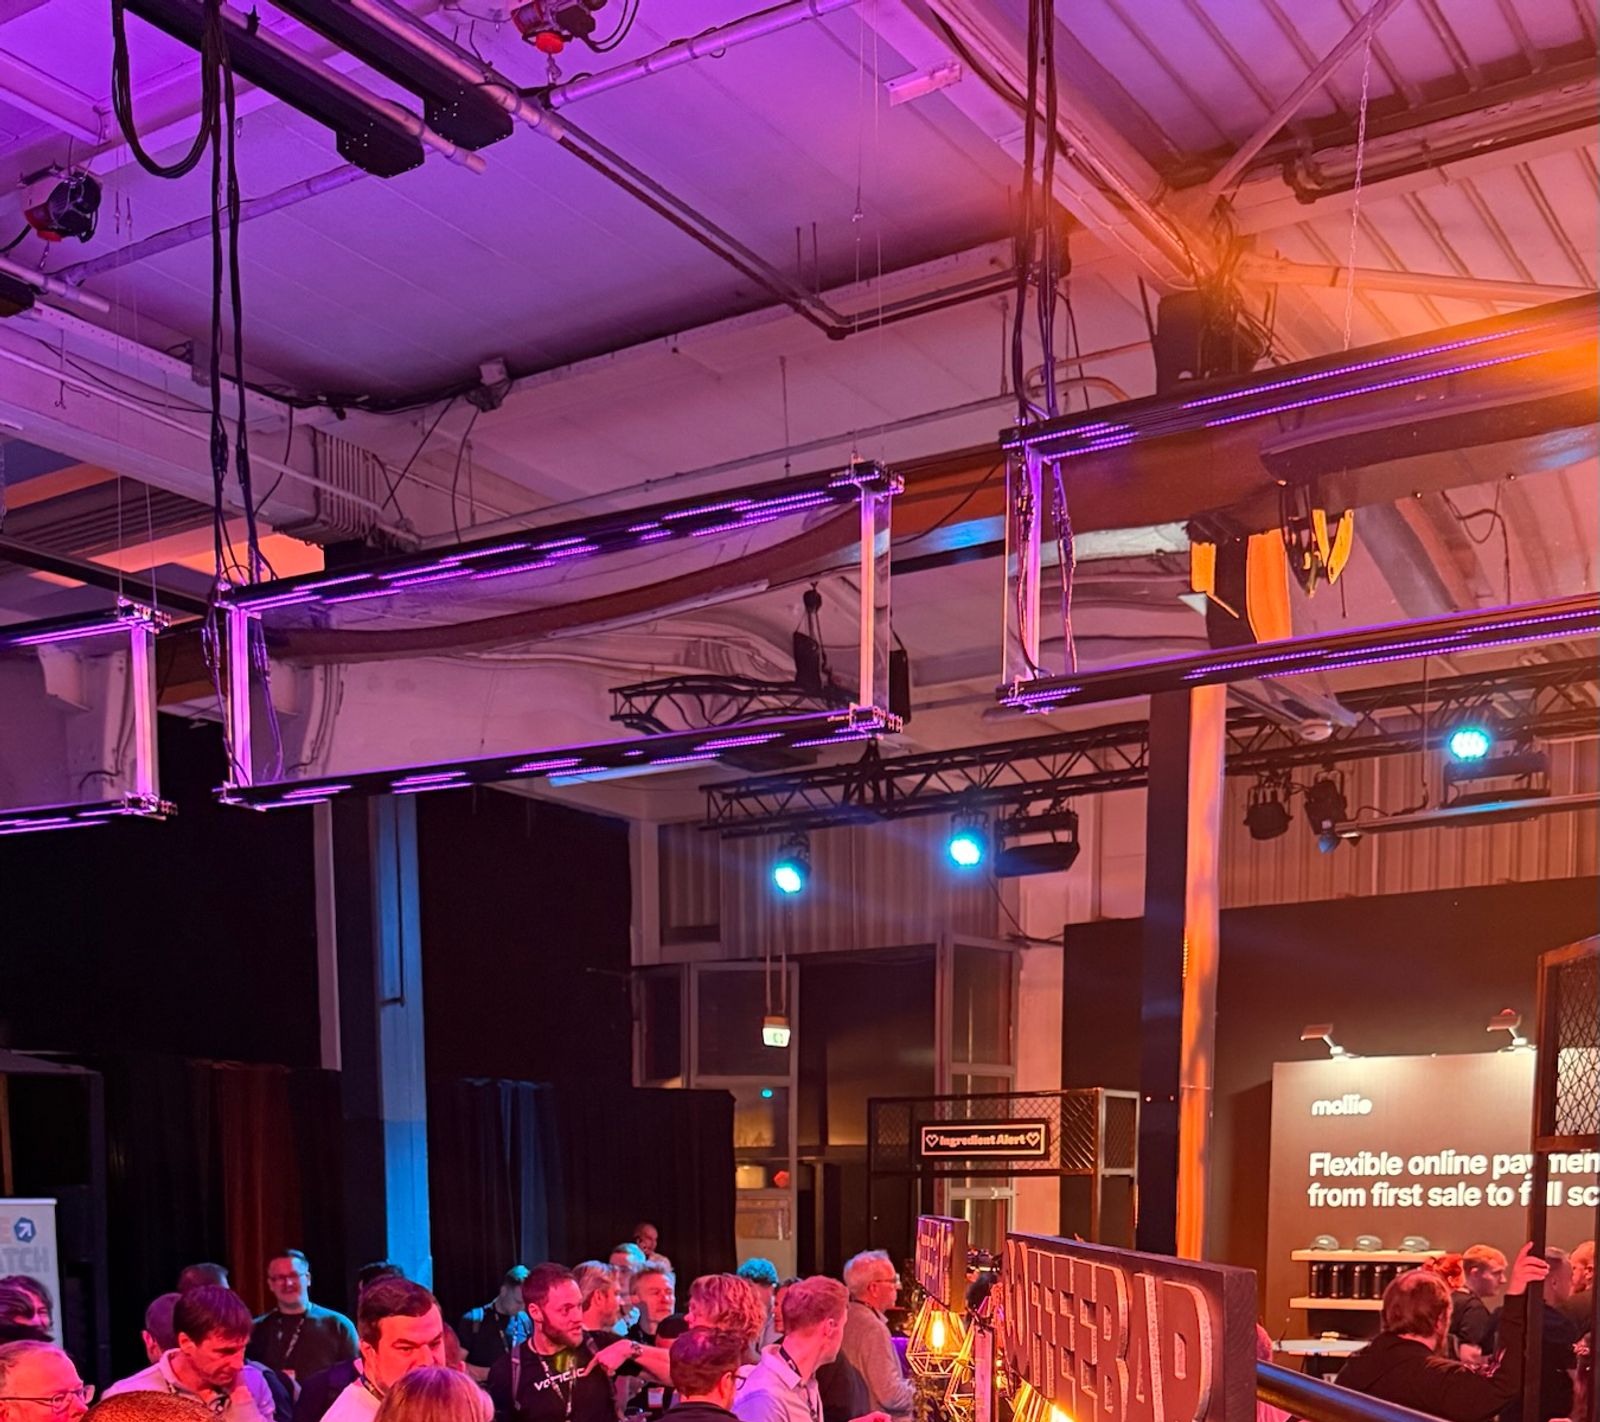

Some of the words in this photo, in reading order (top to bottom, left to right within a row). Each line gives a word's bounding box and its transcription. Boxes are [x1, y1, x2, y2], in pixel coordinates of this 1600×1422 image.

[1311, 1093, 1373, 1116] mollie
[939, 1134, 995, 1148] Ingredient
[996, 1133, 1026, 1146] Alert
[1309, 1152, 1403, 1177] Flexible
[1408, 1150, 1487, 1175] online
[1308, 1183, 1366, 1207] from
[1371, 1182, 1423, 1206] first
[1428, 1182, 1481, 1206] sale
[1486, 1183, 1514, 1206] to
[1518, 1181, 1562, 1206] fll
